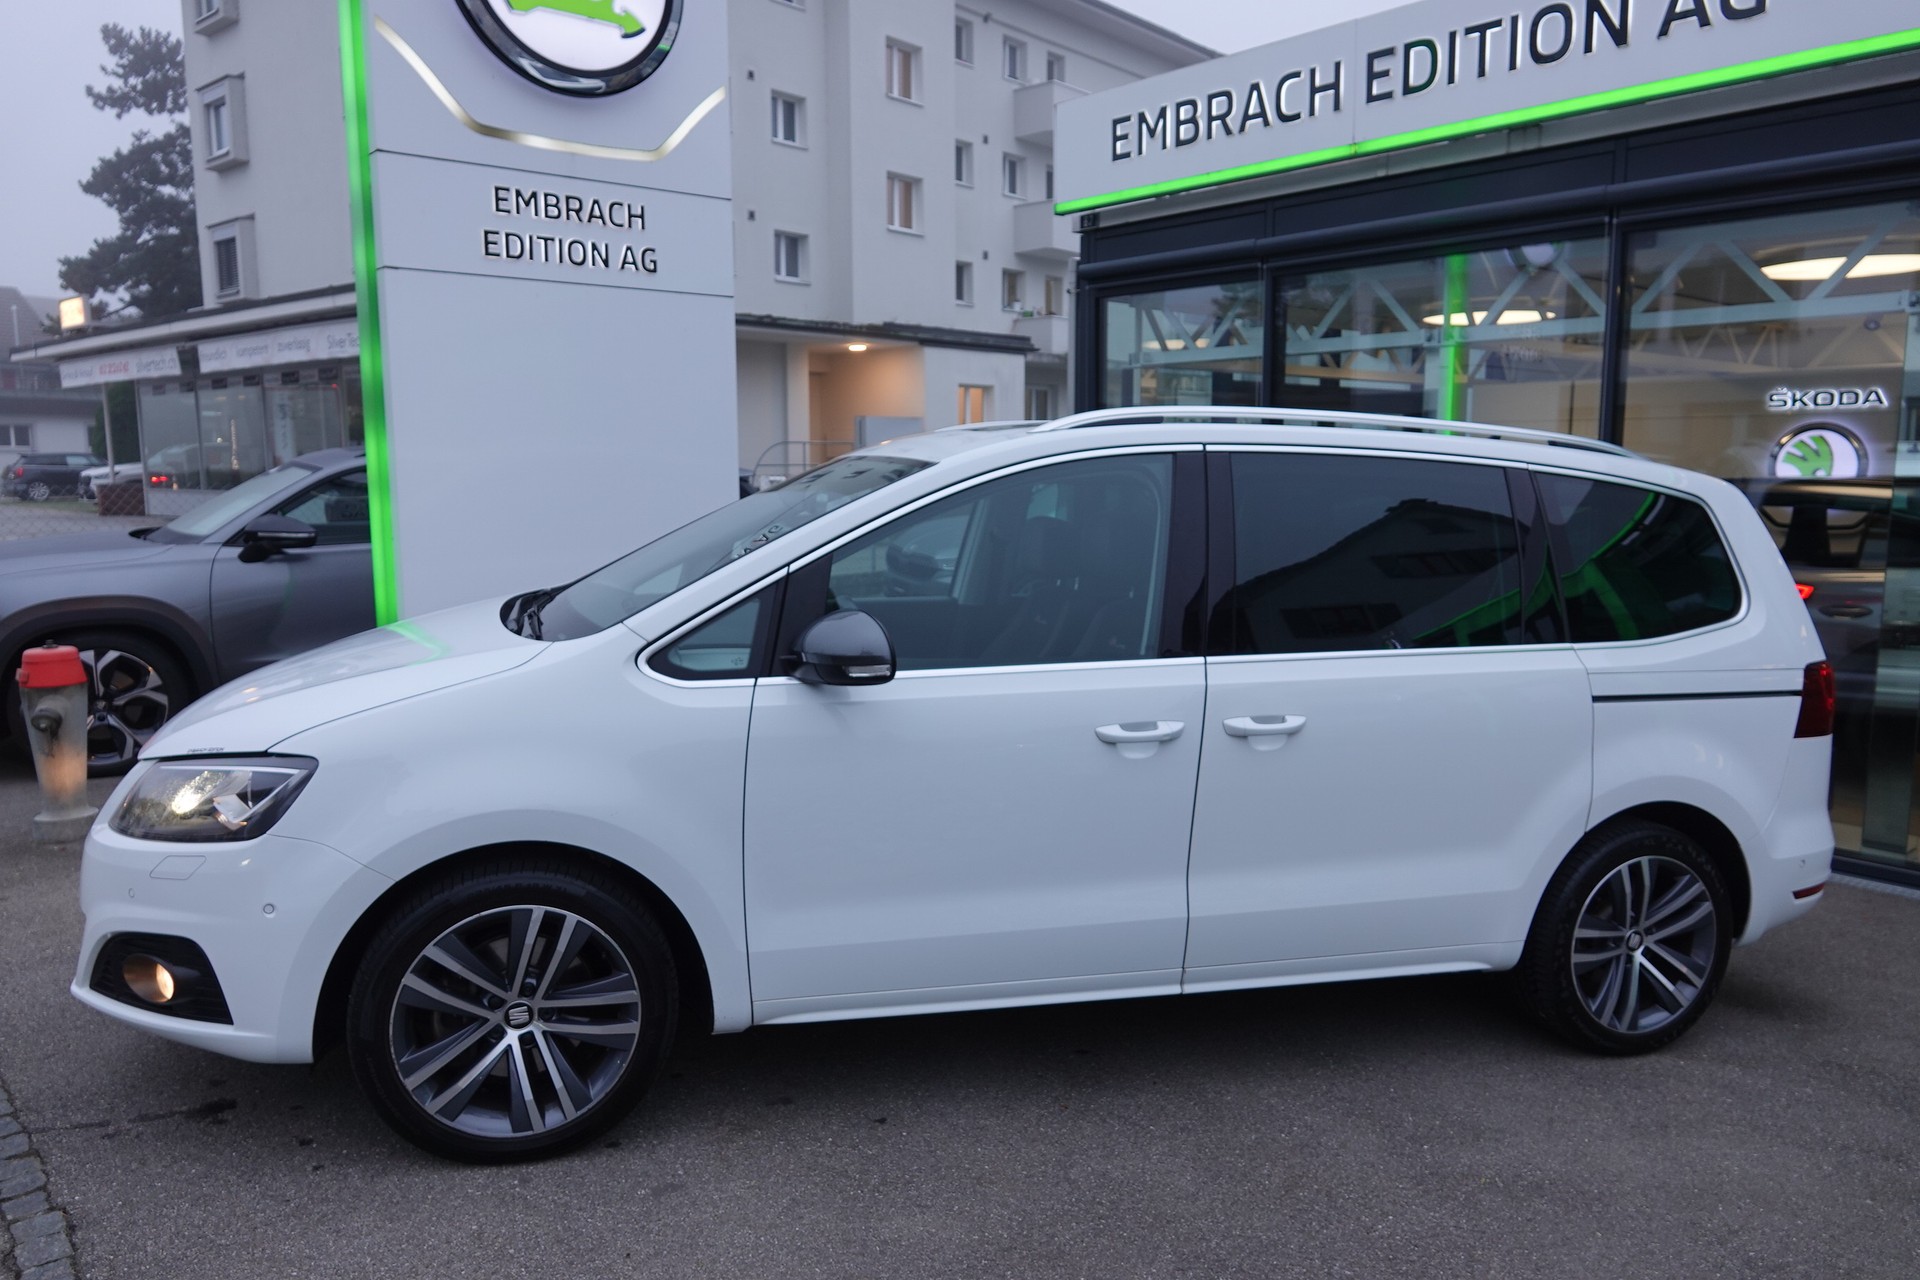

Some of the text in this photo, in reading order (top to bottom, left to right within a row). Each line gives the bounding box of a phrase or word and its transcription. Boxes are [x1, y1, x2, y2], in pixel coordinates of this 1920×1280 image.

[1111, 60, 1343, 162] EMBRACH
[1366, 0, 1630, 104] EDITION
[493, 185, 646, 231] EMBRACH
[482, 229, 658, 273] EDITION AG
[1767, 386, 1889, 411] ŠKODA
